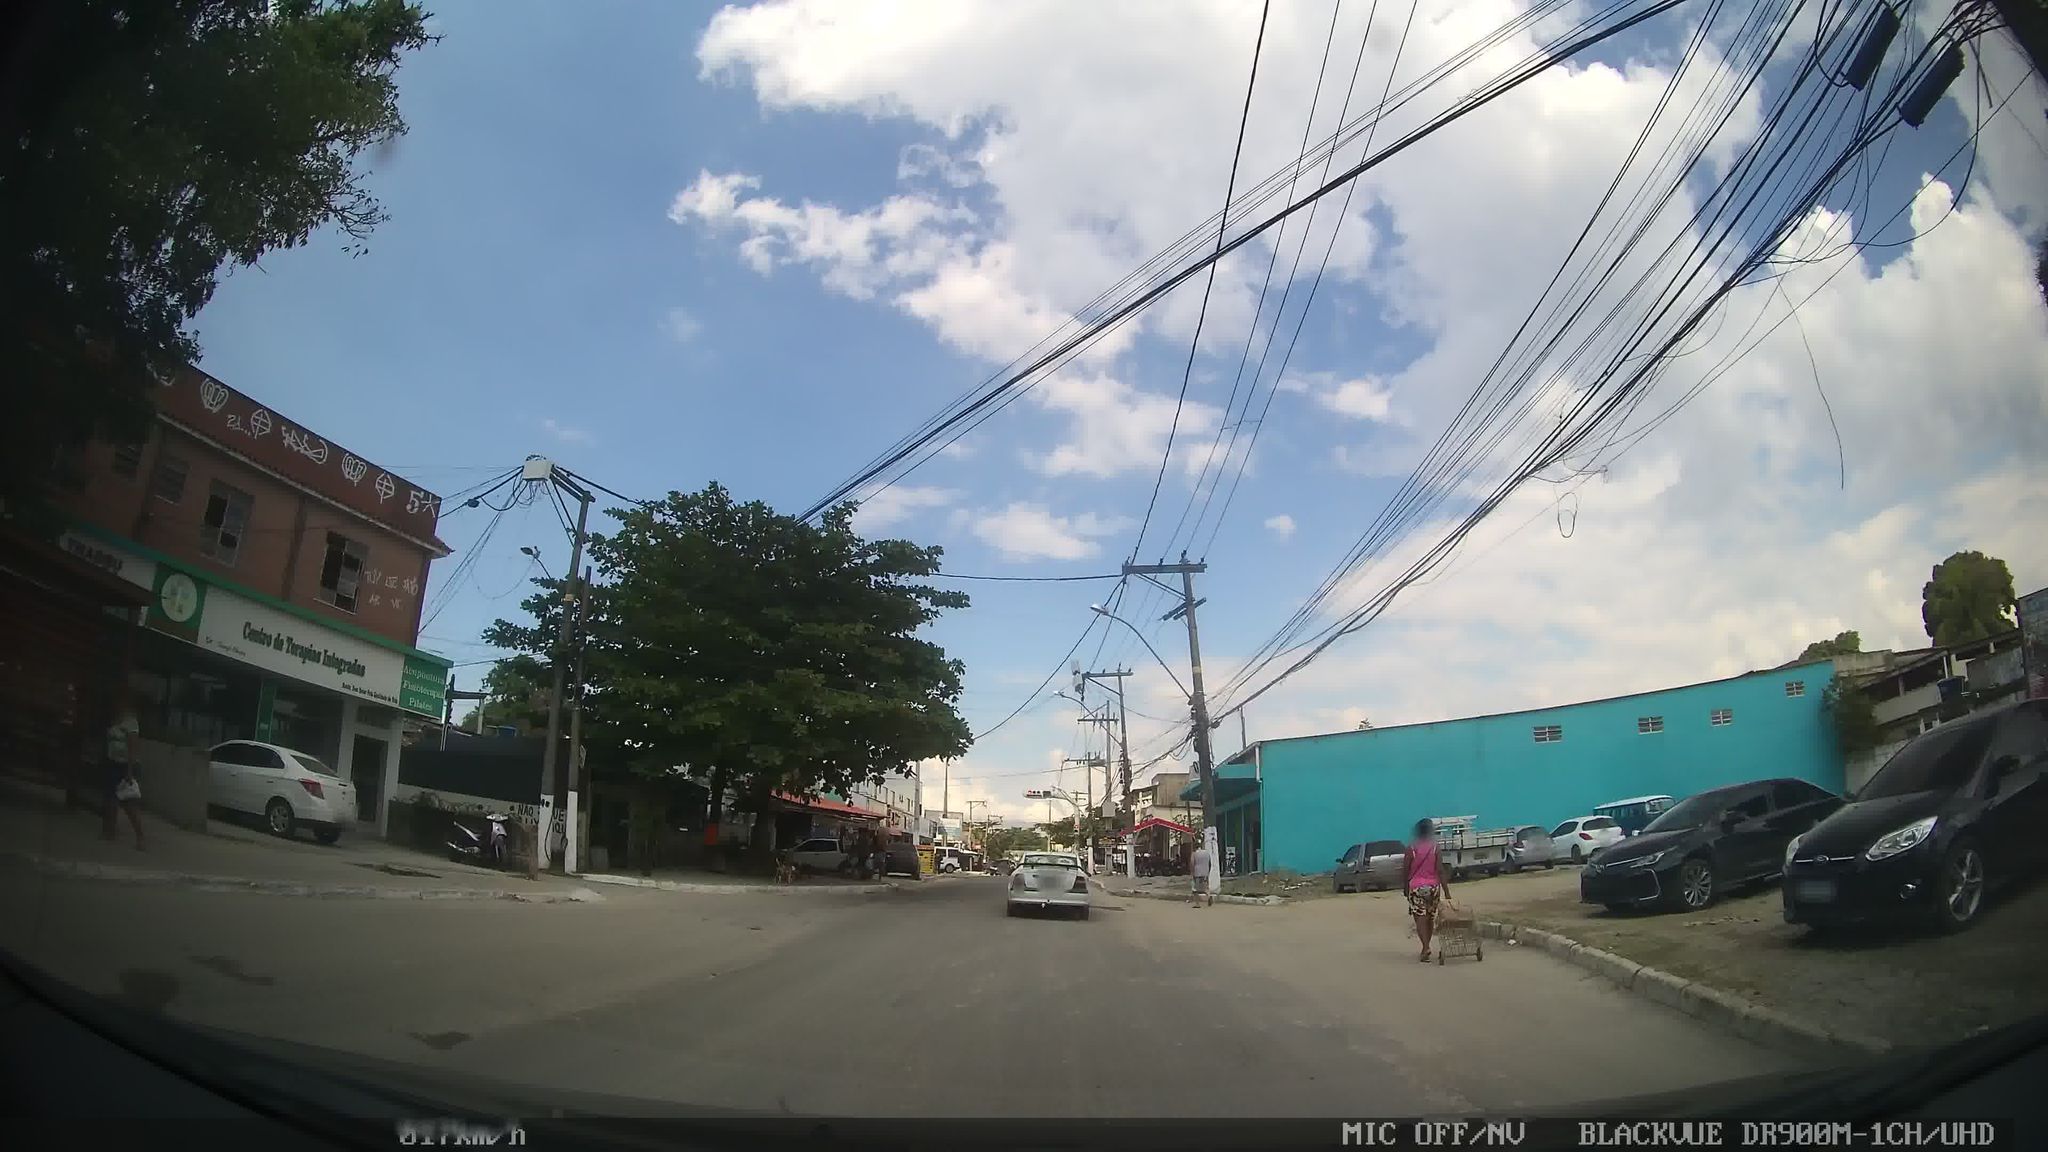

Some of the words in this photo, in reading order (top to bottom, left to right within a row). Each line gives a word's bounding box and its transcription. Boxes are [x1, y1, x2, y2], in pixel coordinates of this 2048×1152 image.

[243, 621, 272, 647] Centro
[273, 633, 284, 651] de
[285, 636, 322, 664] Terapias
[322, 649, 366, 677] Integradas
[409, 697, 433, 711] Pilates
